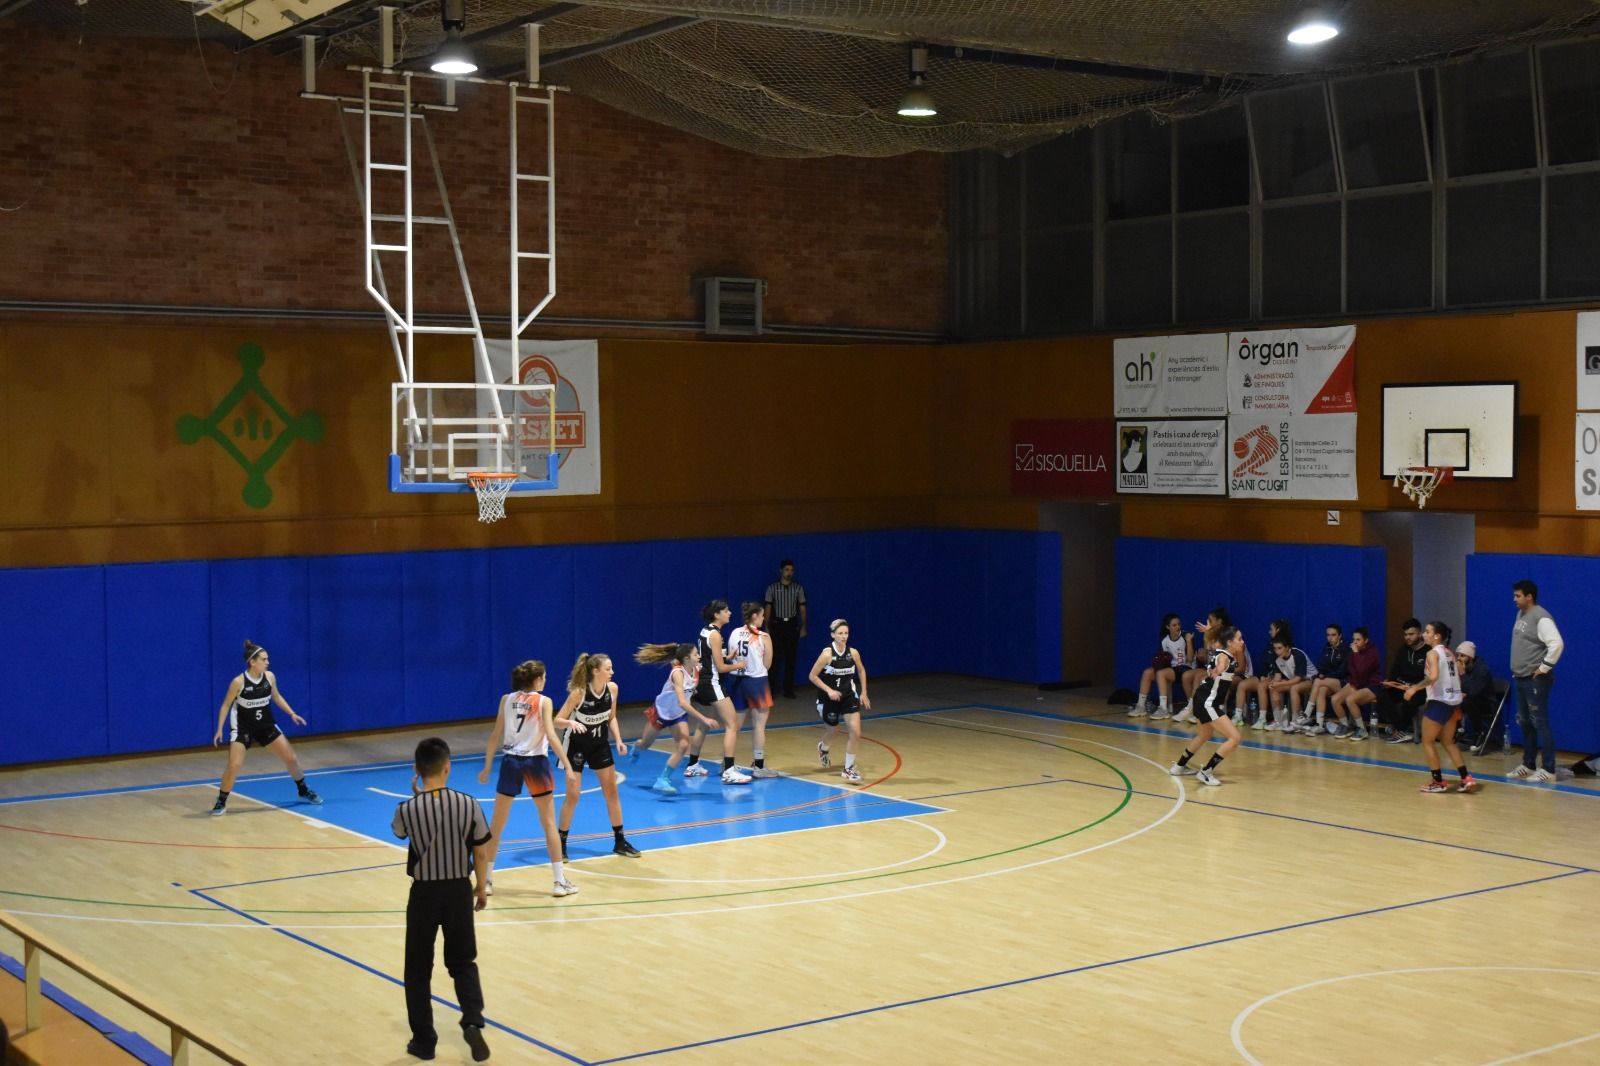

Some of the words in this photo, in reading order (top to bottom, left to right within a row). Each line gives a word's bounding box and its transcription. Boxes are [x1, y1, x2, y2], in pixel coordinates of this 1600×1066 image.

[1192, 429, 1200, 438] de
[1201, 429, 1219, 440] regal
[1280, 422, 1289, 475] ESPORTS
[1036, 454, 1107, 472] SISQUELLA
[1122, 474, 1146, 486] MATILDA
[1231, 479, 1256, 491] SANT
[1258, 479, 1289, 491] CUGAT
[737, 640, 748, 657] 15
[255, 709, 263, 720] 5
[516, 714, 525, 733] 7
[591, 726, 601, 738] 11
